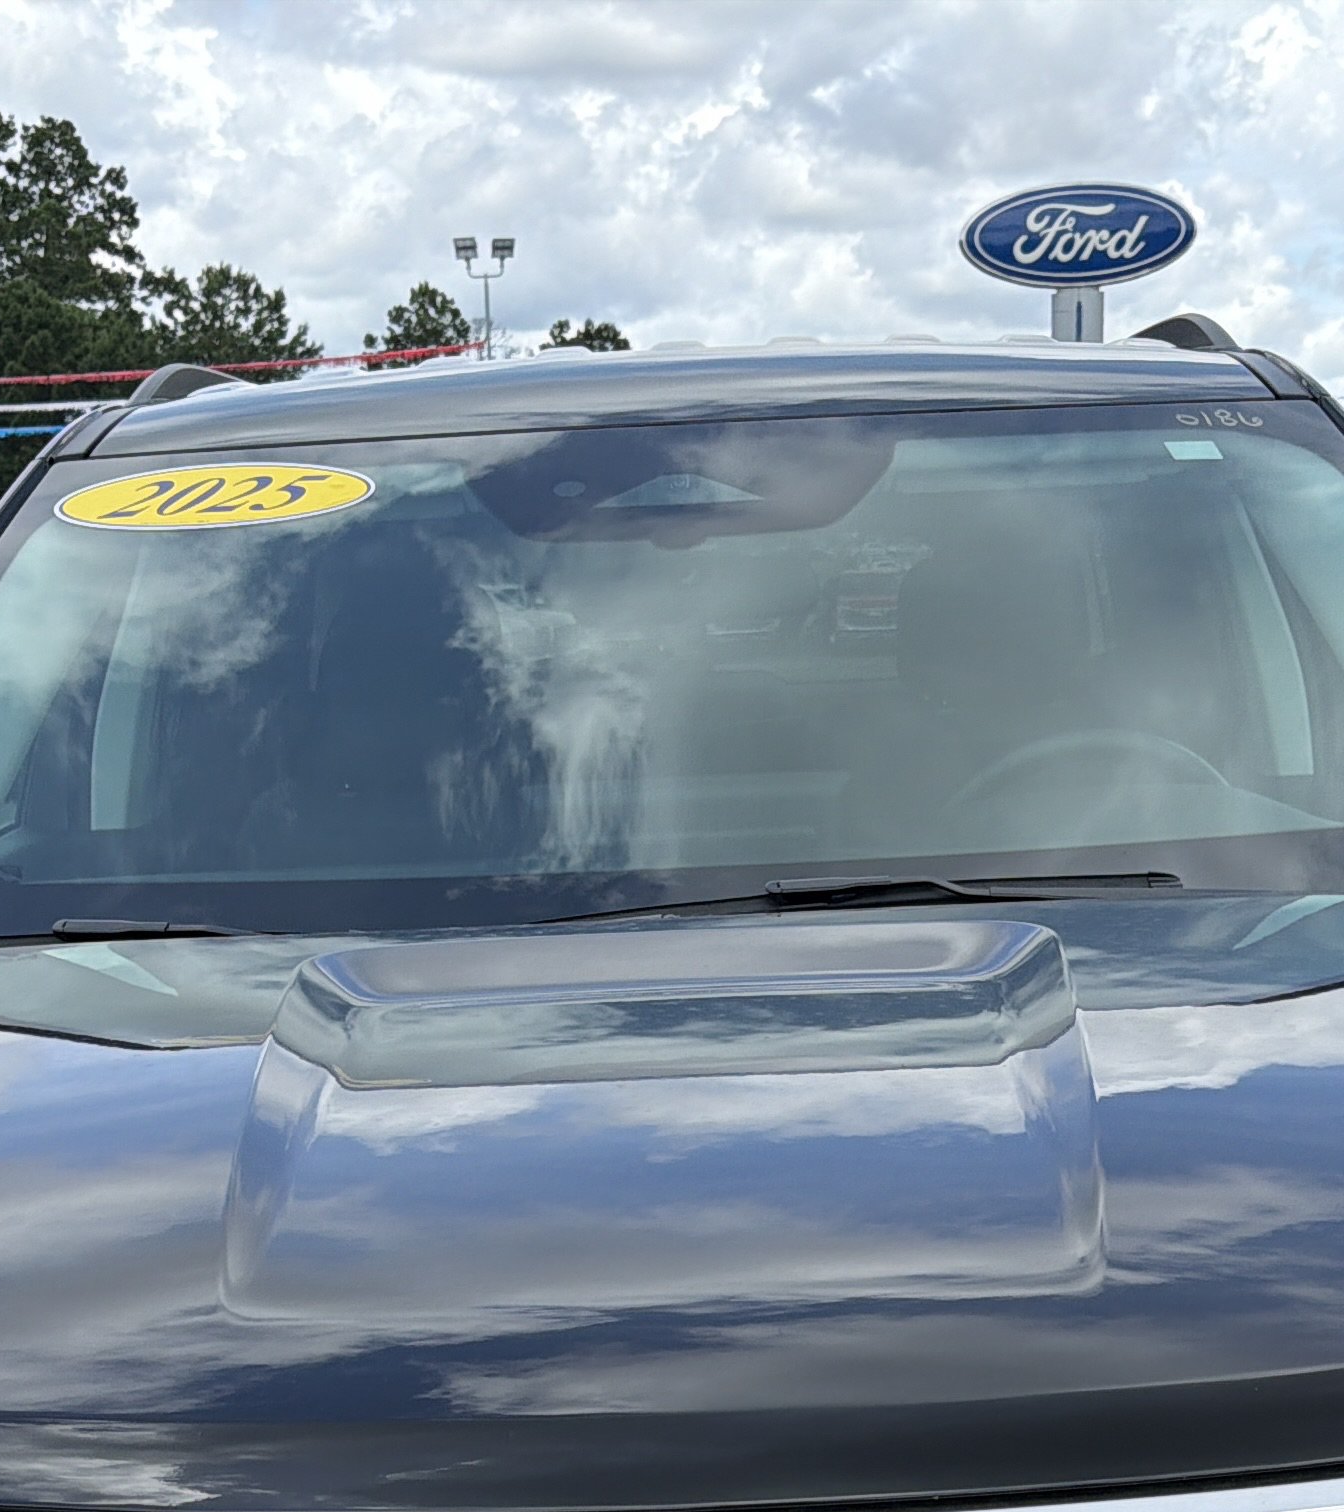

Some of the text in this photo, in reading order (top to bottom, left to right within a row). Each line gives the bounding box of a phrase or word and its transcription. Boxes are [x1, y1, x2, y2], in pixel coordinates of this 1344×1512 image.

[1013, 202, 1149, 264] Ford
[1176, 409, 1264, 427] 0186
[96, 475, 333, 520] 2025
